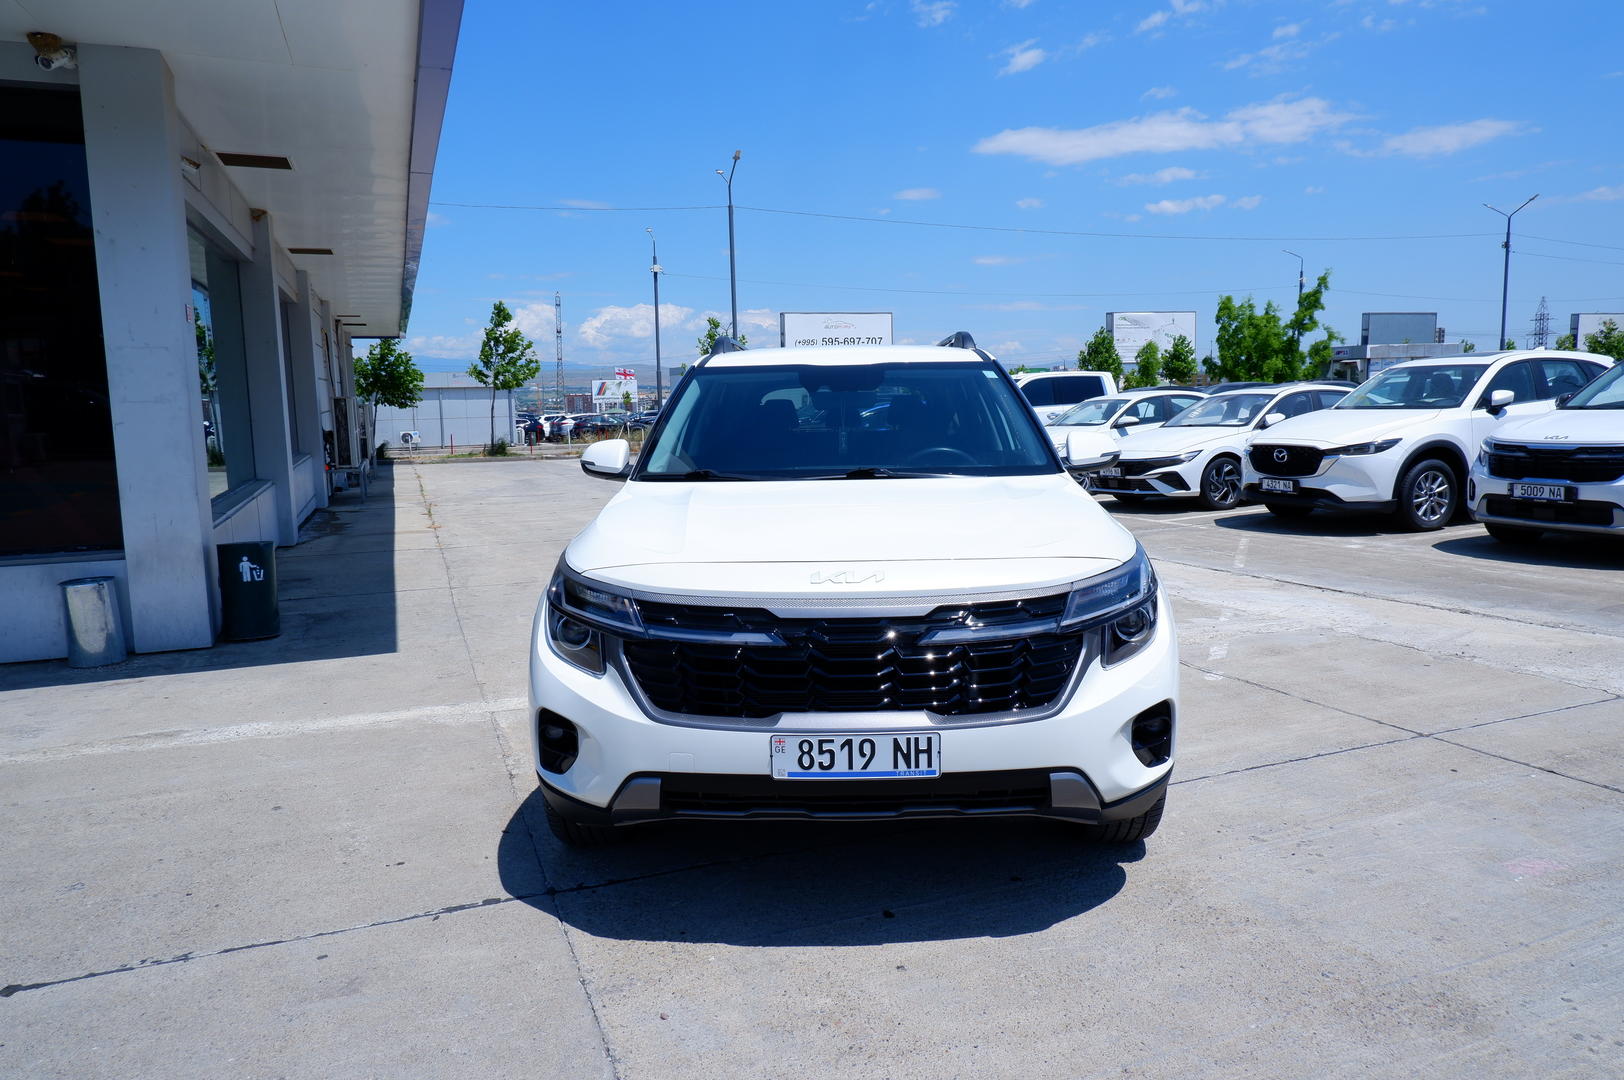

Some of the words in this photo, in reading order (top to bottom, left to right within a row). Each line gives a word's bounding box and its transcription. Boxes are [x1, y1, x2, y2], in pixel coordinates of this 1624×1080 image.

[794, 339, 817, 347] (+995)
[821, 337, 883, 346] 595-697-707
[1266, 480, 1281, 488] 4321
[1283, 481, 1291, 489] NA
[1520, 485, 1545, 497] 5009
[1548, 487, 1562, 498] NA
[797, 738, 876, 770] 8519
[892, 736, 933, 769] NH
